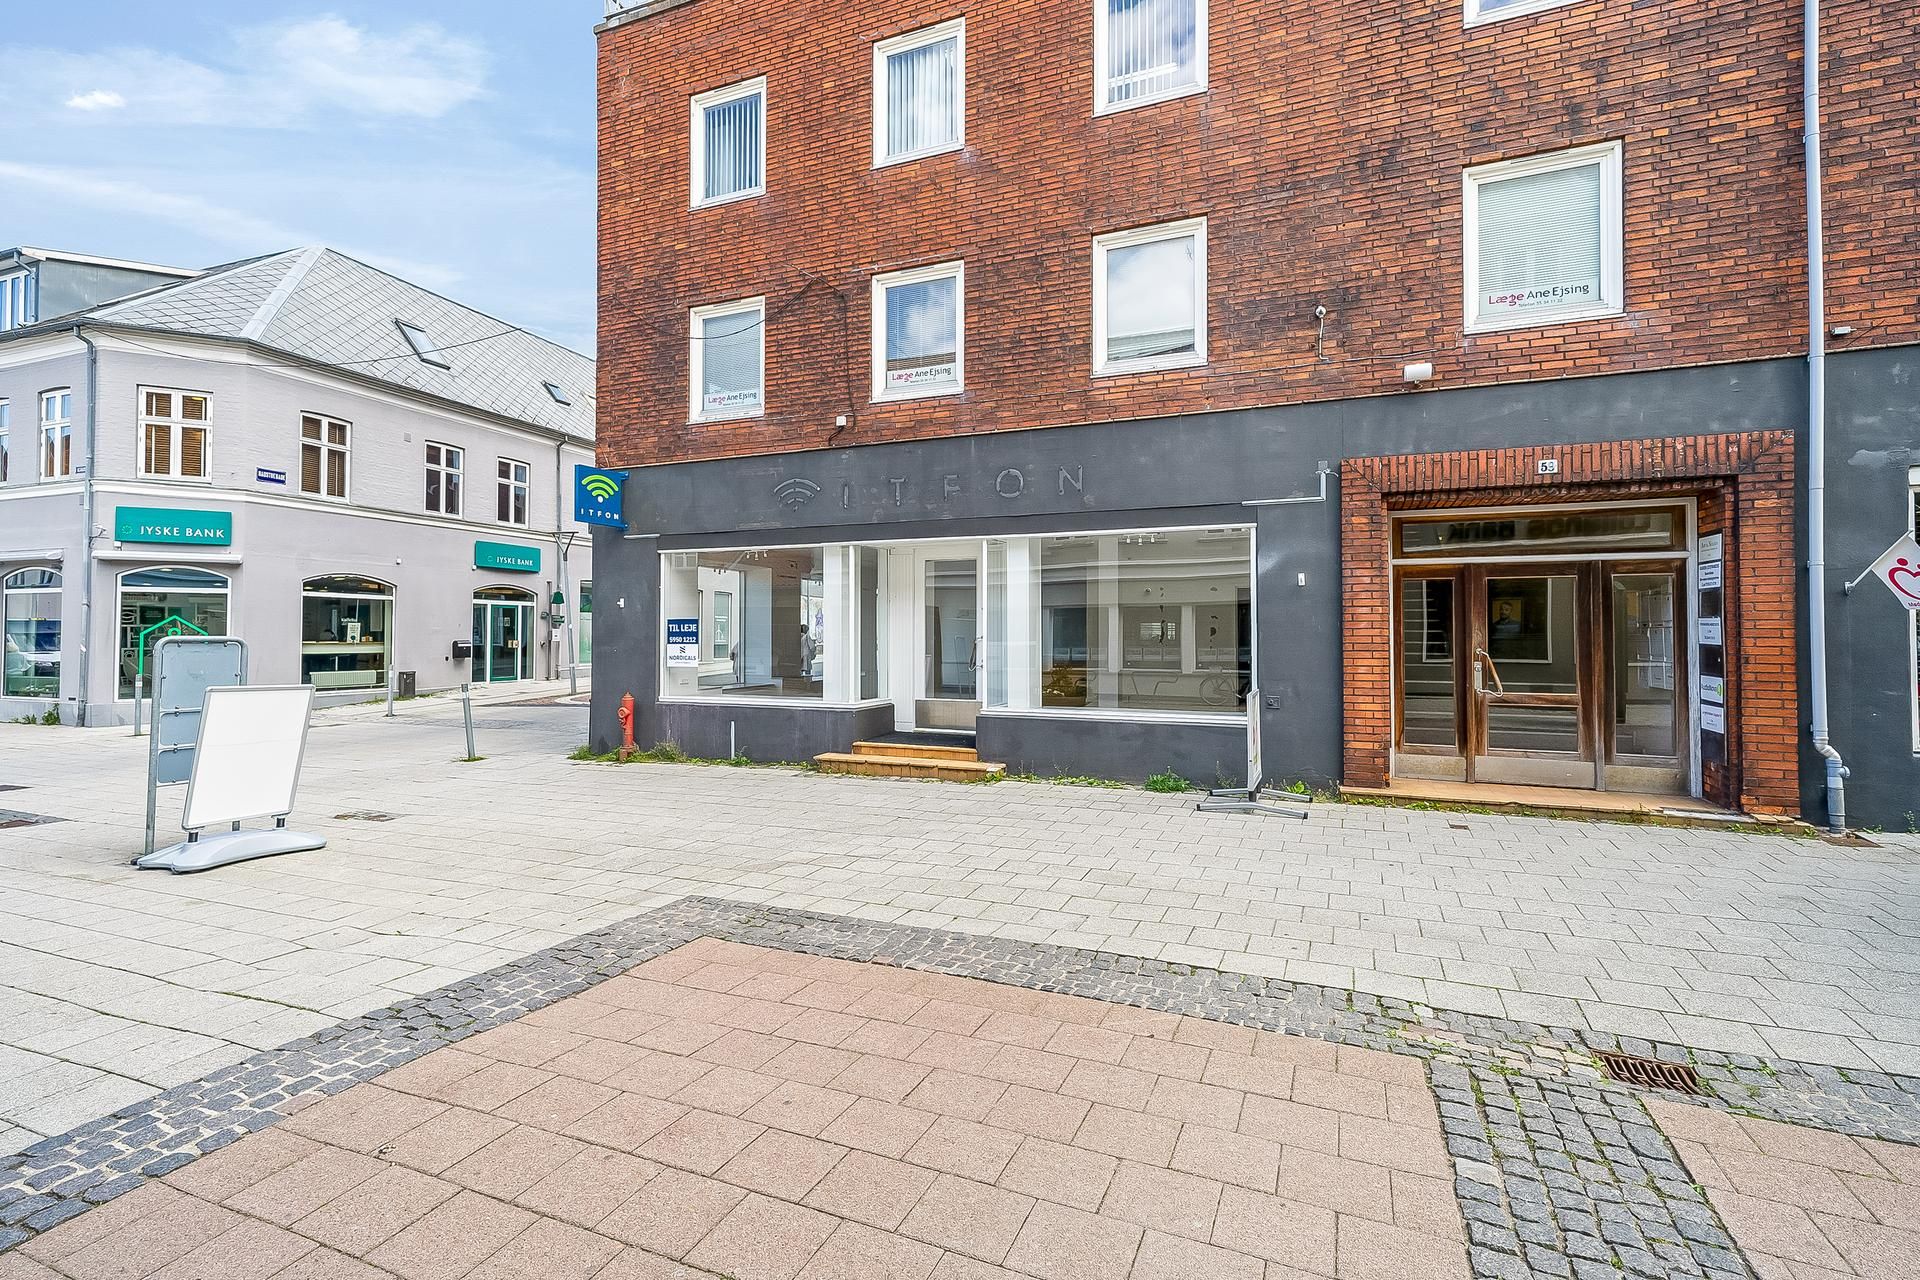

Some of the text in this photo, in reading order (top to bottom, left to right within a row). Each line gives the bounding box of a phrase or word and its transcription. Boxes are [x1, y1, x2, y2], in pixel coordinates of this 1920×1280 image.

[1488, 284, 1590, 306] Læge Ane Ejsing
[892, 372, 914, 382] Læge
[929, 367, 952, 377] Ejsing
[739, 392, 757, 400] Ejsing
[843, 465, 1083, 509] ITFON
[580, 508, 619, 520] ITFON
[140, 525, 225, 538] JYSKE BANK
[496, 556, 534, 566] JYSKE BANK
[668, 624, 697, 632] TIL LEJE
